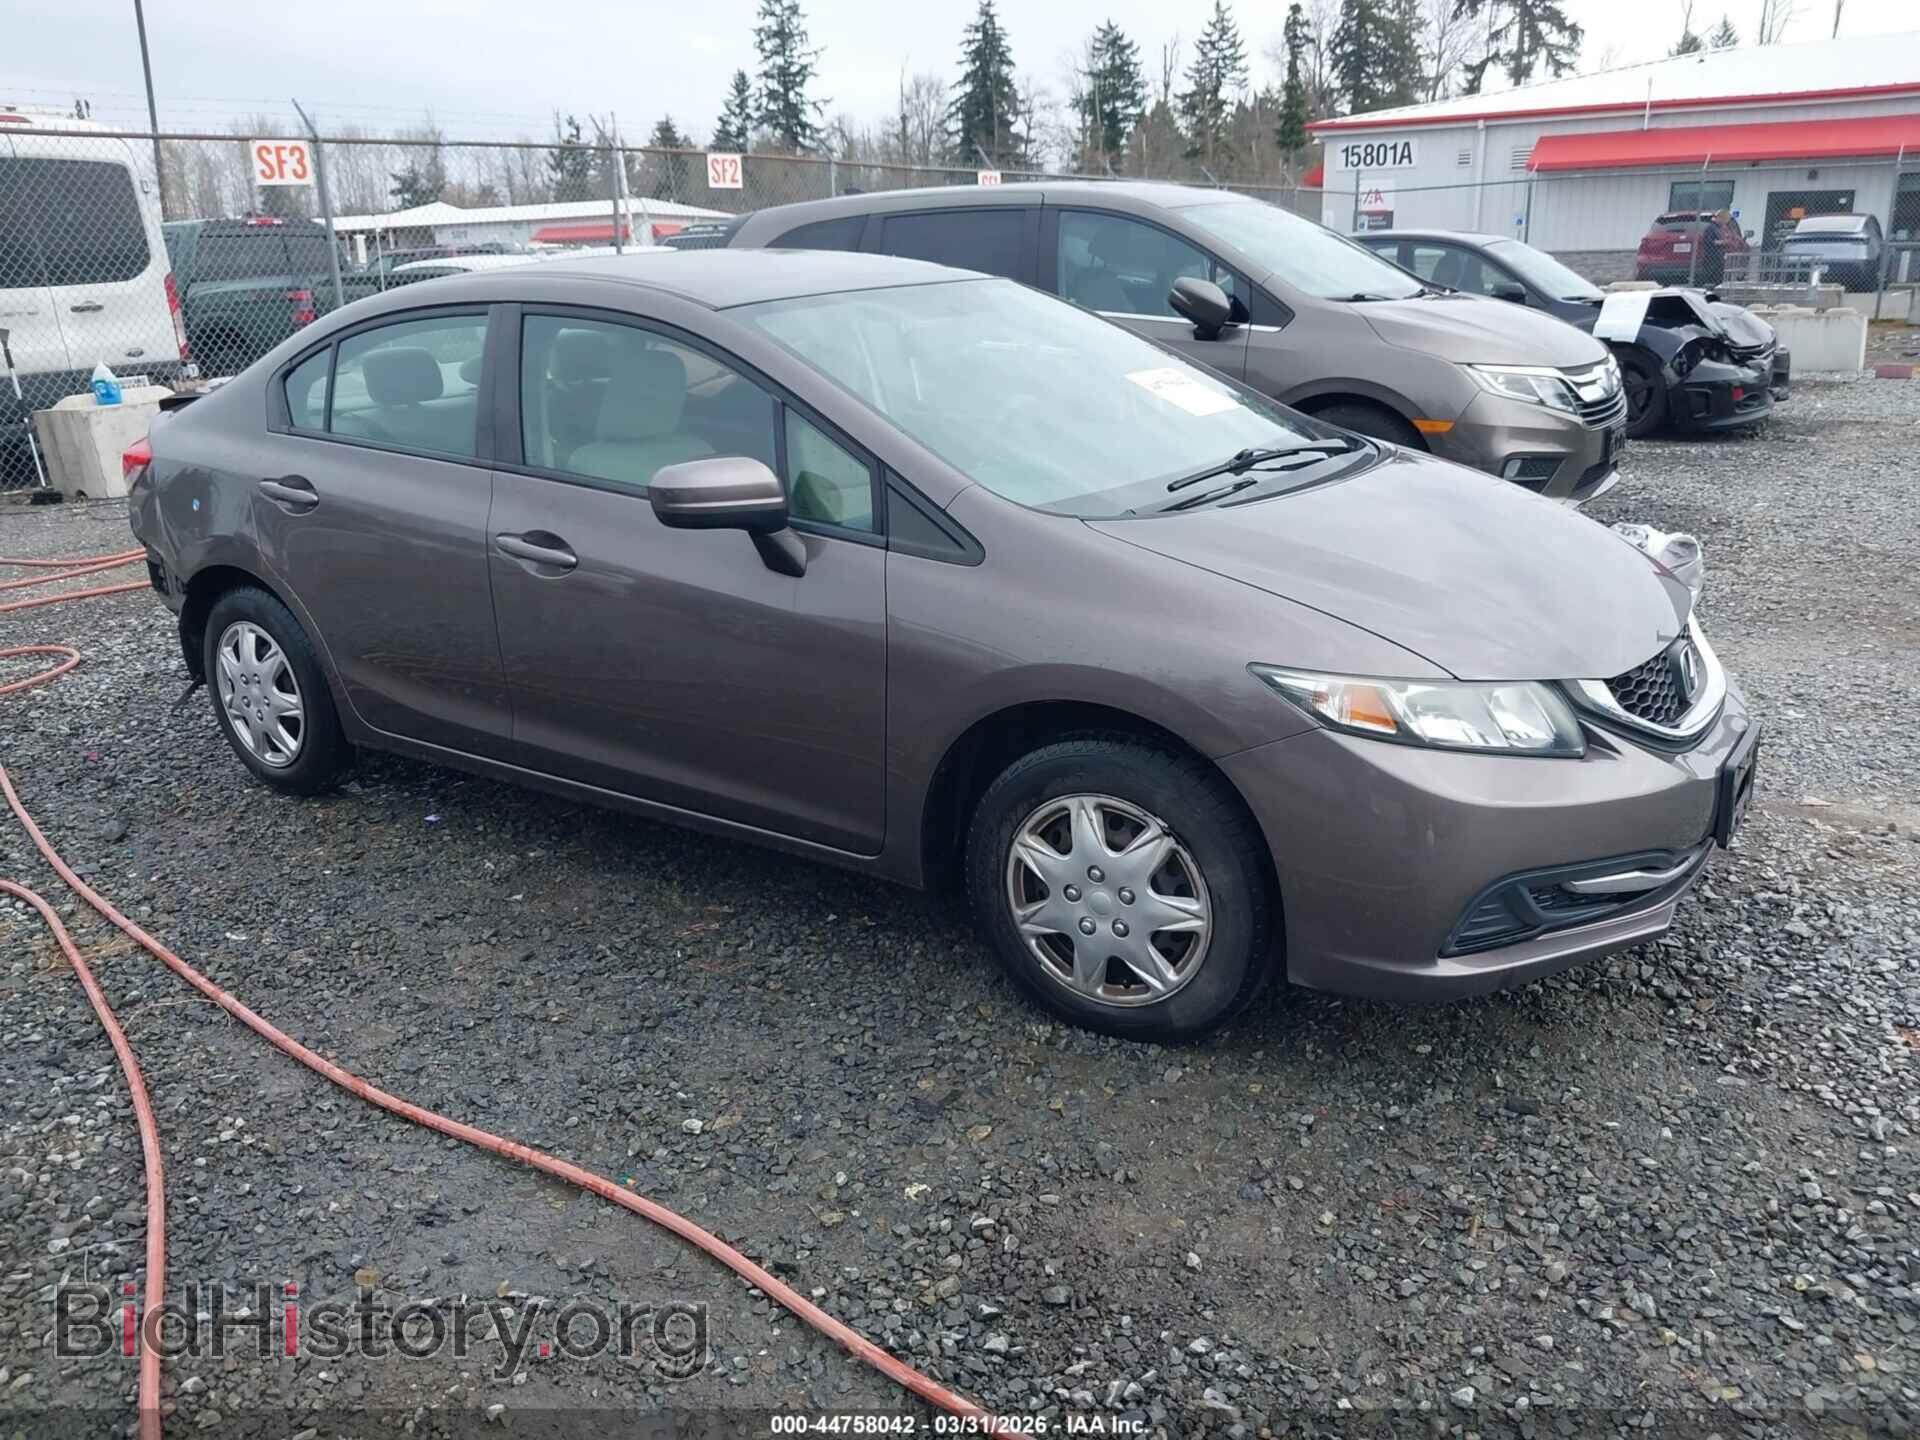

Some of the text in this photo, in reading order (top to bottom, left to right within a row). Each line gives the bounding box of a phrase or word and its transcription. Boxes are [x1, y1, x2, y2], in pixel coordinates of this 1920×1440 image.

[256, 145, 308, 180] SF3
[1341, 141, 1413, 168] 15801A
[711, 158, 739, 184] SF2
